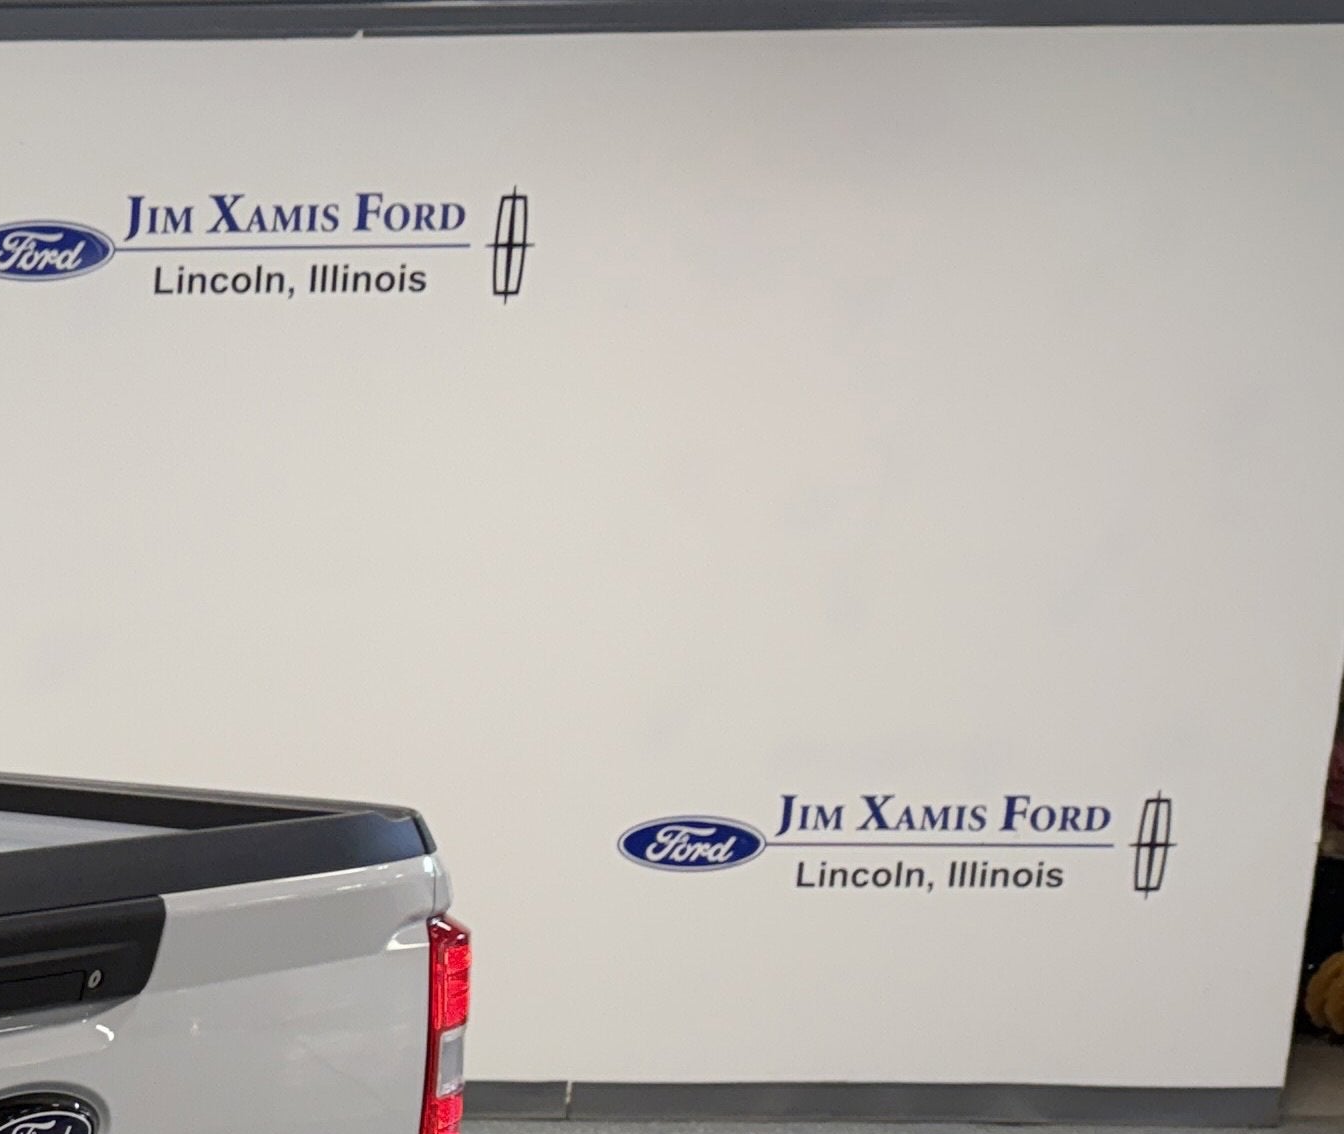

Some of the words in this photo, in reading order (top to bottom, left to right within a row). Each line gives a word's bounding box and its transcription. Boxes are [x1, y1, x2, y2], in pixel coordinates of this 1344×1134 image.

[353, 192, 467, 233] FORD
[154, 265, 296, 299] Lincoln,
[309, 265, 427, 294] Illinois
[997, 795, 1112, 832] FORD
[645, 825, 735, 864] Ford
[796, 860, 935, 893] Lincoln,
[948, 861, 1065, 889] Illinois
